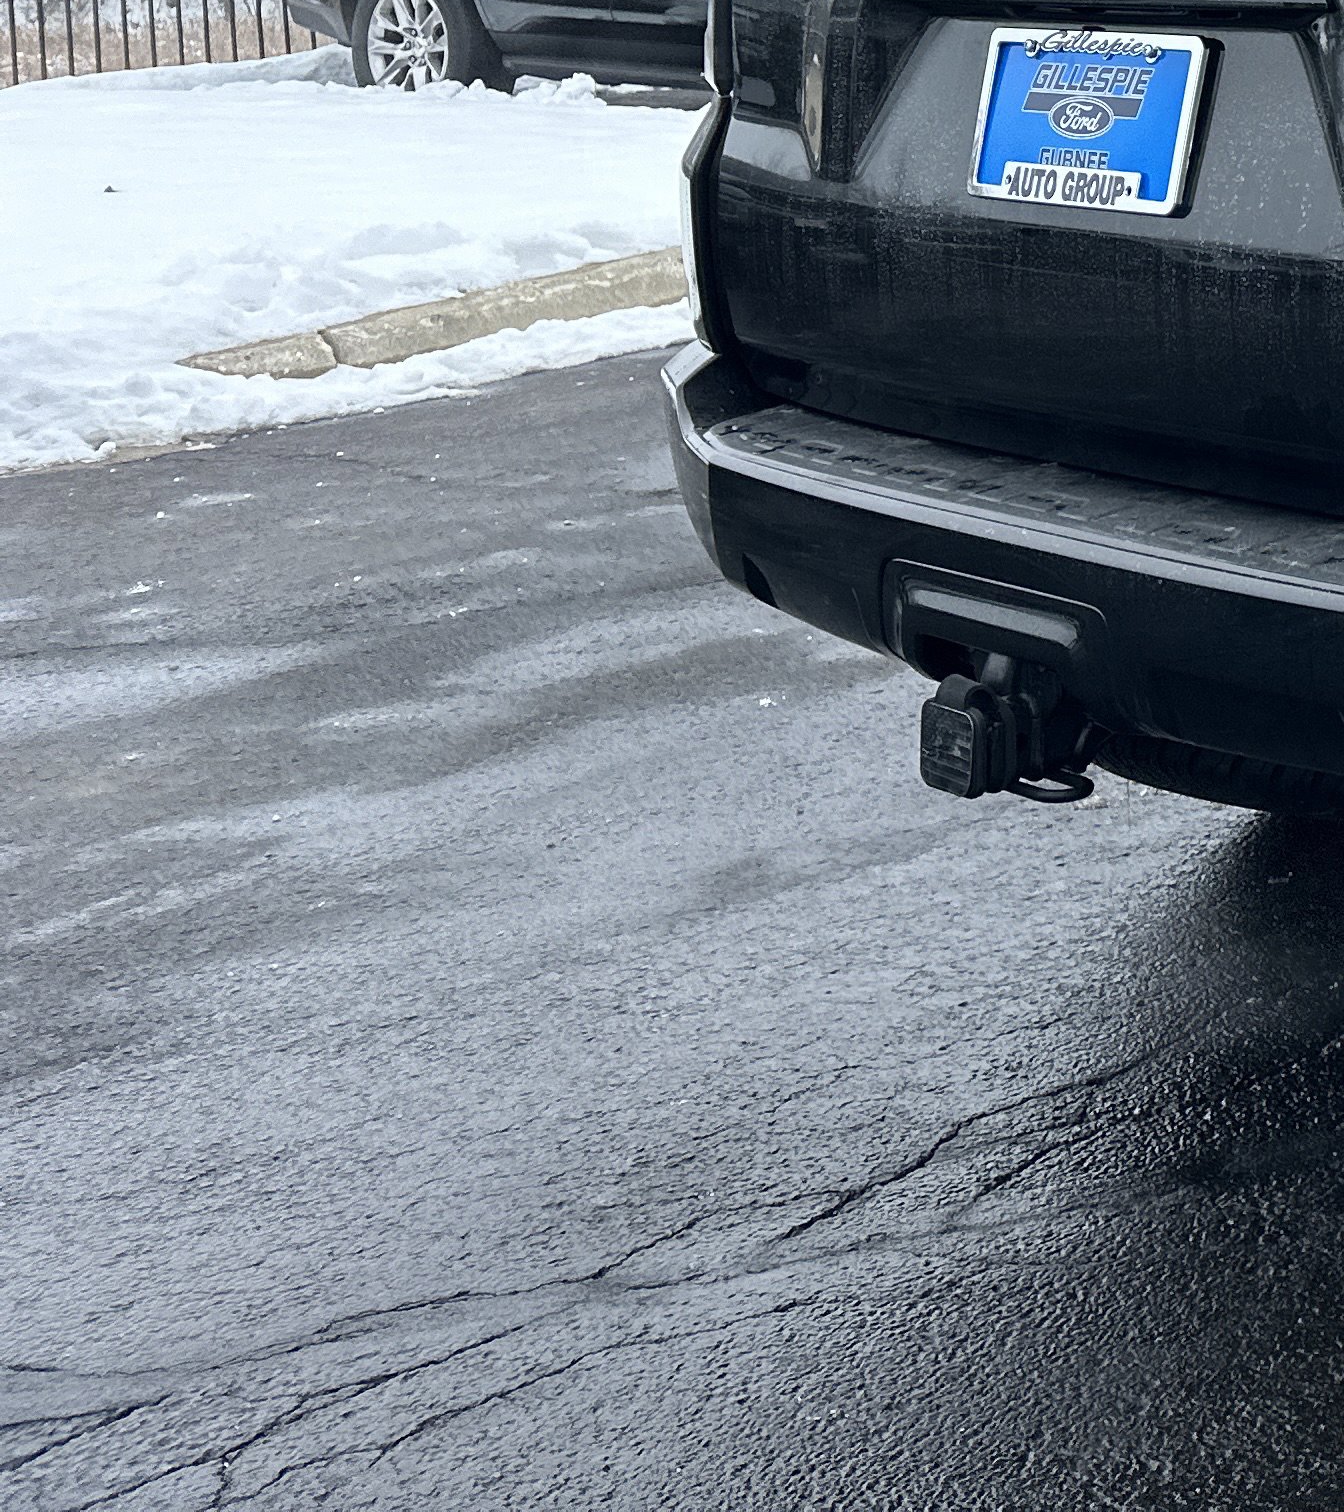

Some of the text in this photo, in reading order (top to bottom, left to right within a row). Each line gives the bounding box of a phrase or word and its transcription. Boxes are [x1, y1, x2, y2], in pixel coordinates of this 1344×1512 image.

[1038, 30, 1146, 60] Gillespie
[1031, 62, 1154, 97] GILLESPIE
[1059, 102, 1102, 132] Ford
[1039, 146, 1110, 170] GURNEE
[1008, 166, 1126, 206] AUTO GROUP
